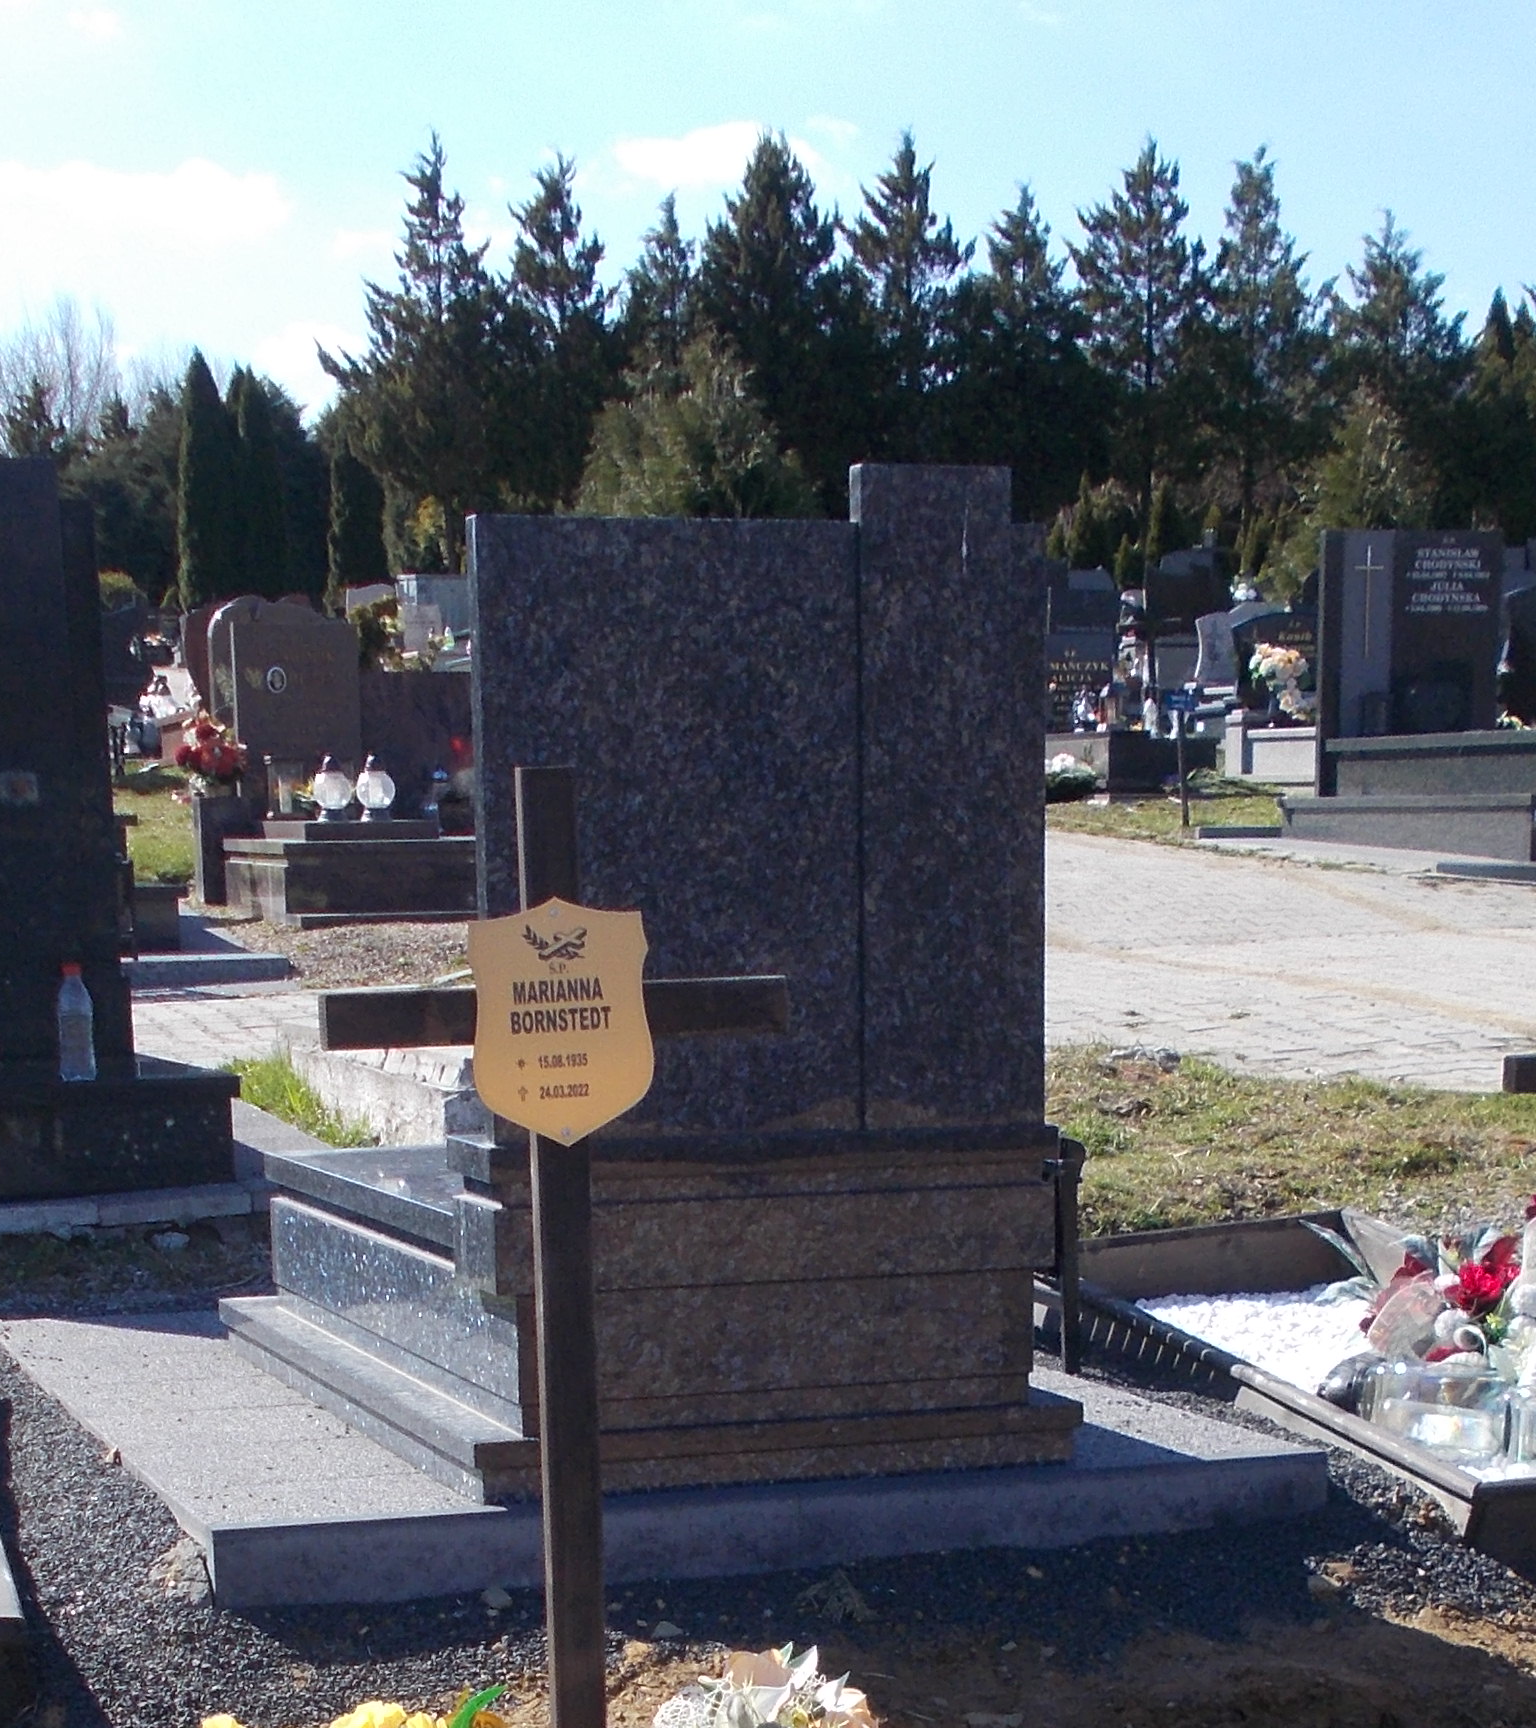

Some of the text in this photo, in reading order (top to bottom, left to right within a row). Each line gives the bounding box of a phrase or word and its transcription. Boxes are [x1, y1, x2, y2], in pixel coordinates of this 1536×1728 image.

[512, 976, 605, 1005] MARIANNA
[510, 1005, 612, 1036] BORNSTEDT
[537, 1052, 589, 1070] 15.08.1935
[539, 1083, 590, 1101] 24.03.2022
